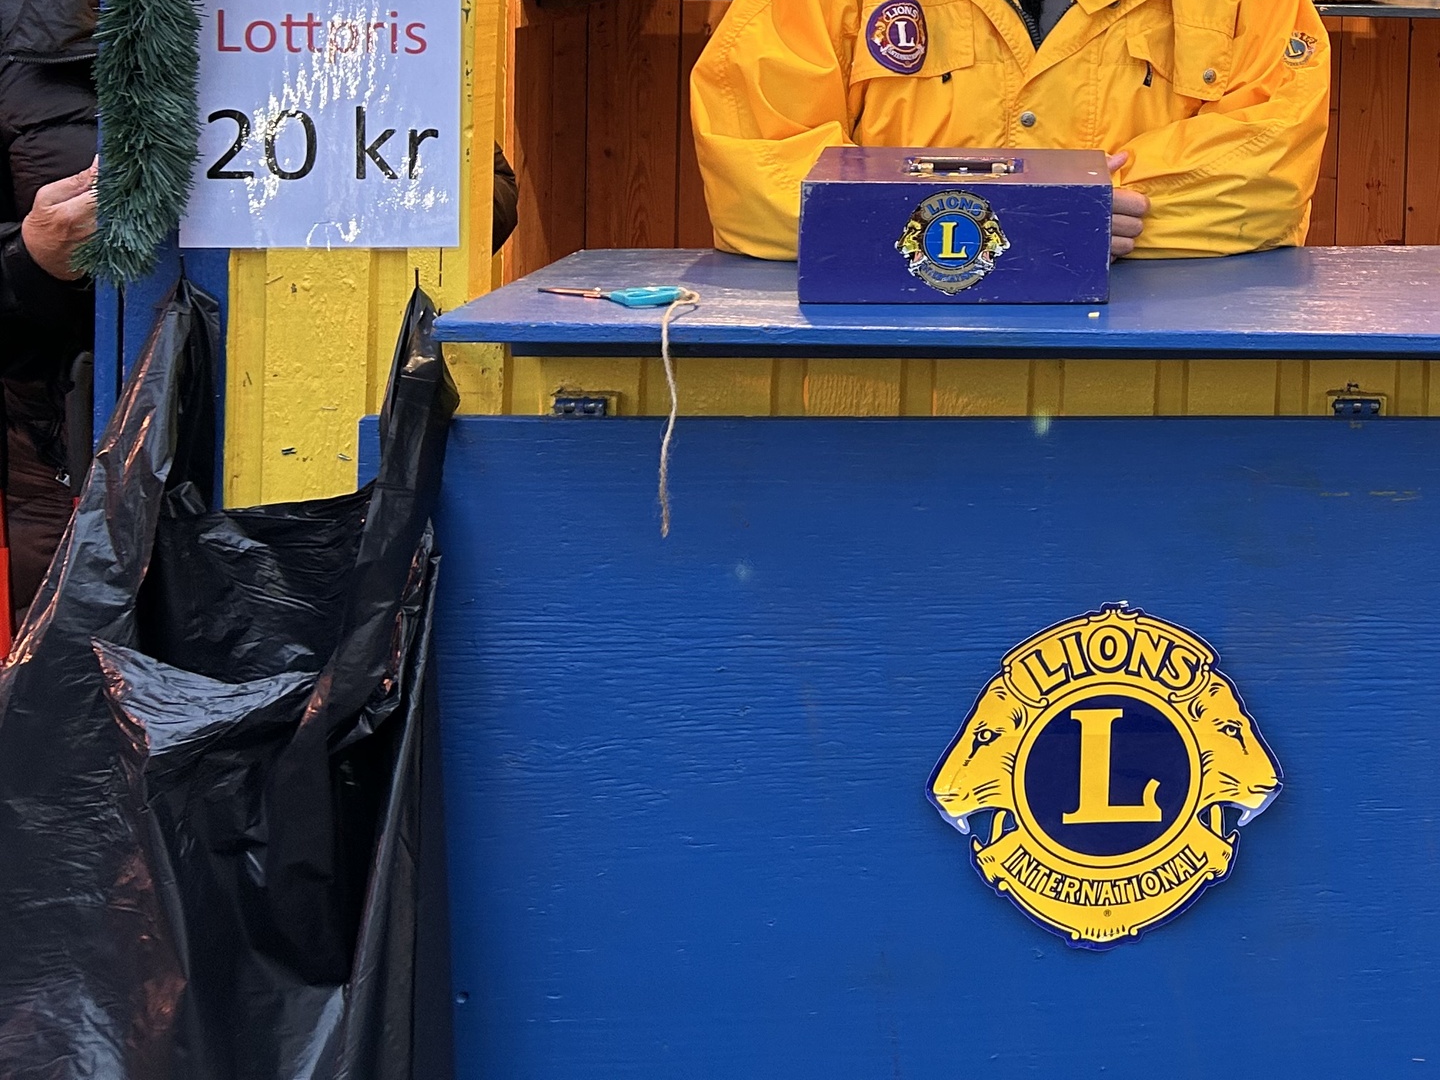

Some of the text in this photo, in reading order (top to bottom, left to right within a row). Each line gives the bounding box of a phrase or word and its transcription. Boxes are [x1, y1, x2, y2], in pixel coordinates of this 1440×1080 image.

[217, 9, 428, 65] Lottpris
[885, 6, 919, 19] LIONS
[895, 21, 915, 47] L
[206, 106, 439, 181] 20 kr
[926, 195, 983, 217] LIONS
[937, 221, 968, 259] L
[1021, 623, 1203, 696] LIONS
[1062, 708, 1163, 825] L
[1001, 843, 1210, 908] INTERNATIONAL
